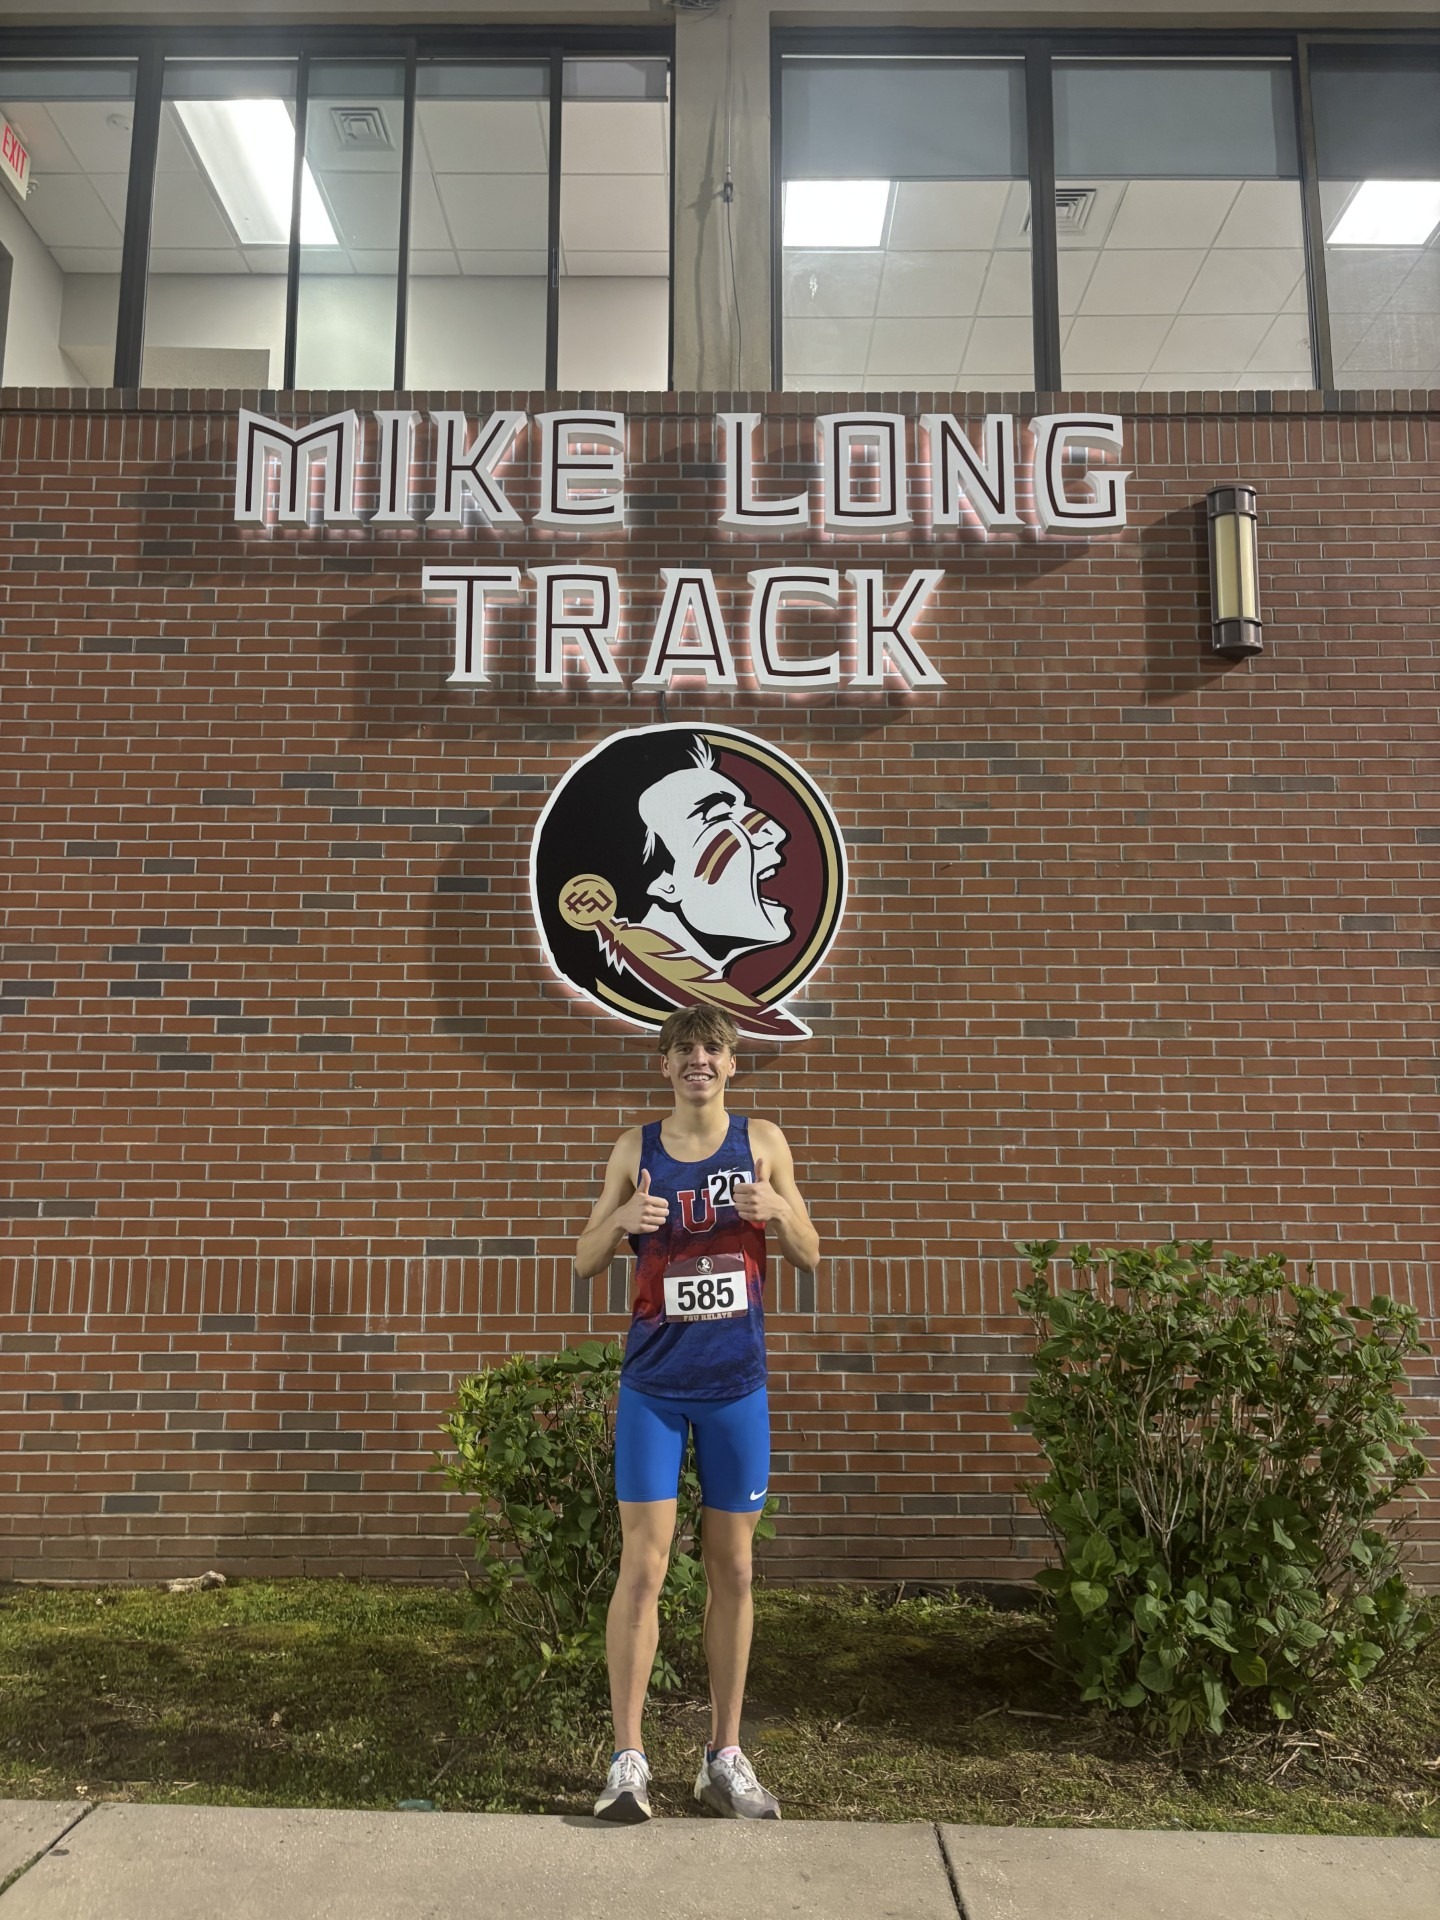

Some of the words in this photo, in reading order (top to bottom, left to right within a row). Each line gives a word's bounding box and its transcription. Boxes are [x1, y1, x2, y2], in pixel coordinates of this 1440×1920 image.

[2, 125, 28, 179] EXIT
[234, 408, 625, 530] MIKE
[716, 411, 1134, 534] LONG
[422, 565, 948, 691] TRACK
[677, 1188, 717, 1234] U
[678, 1277, 734, 1312] 585
[701, 1311, 733, 1321] RELAYS
